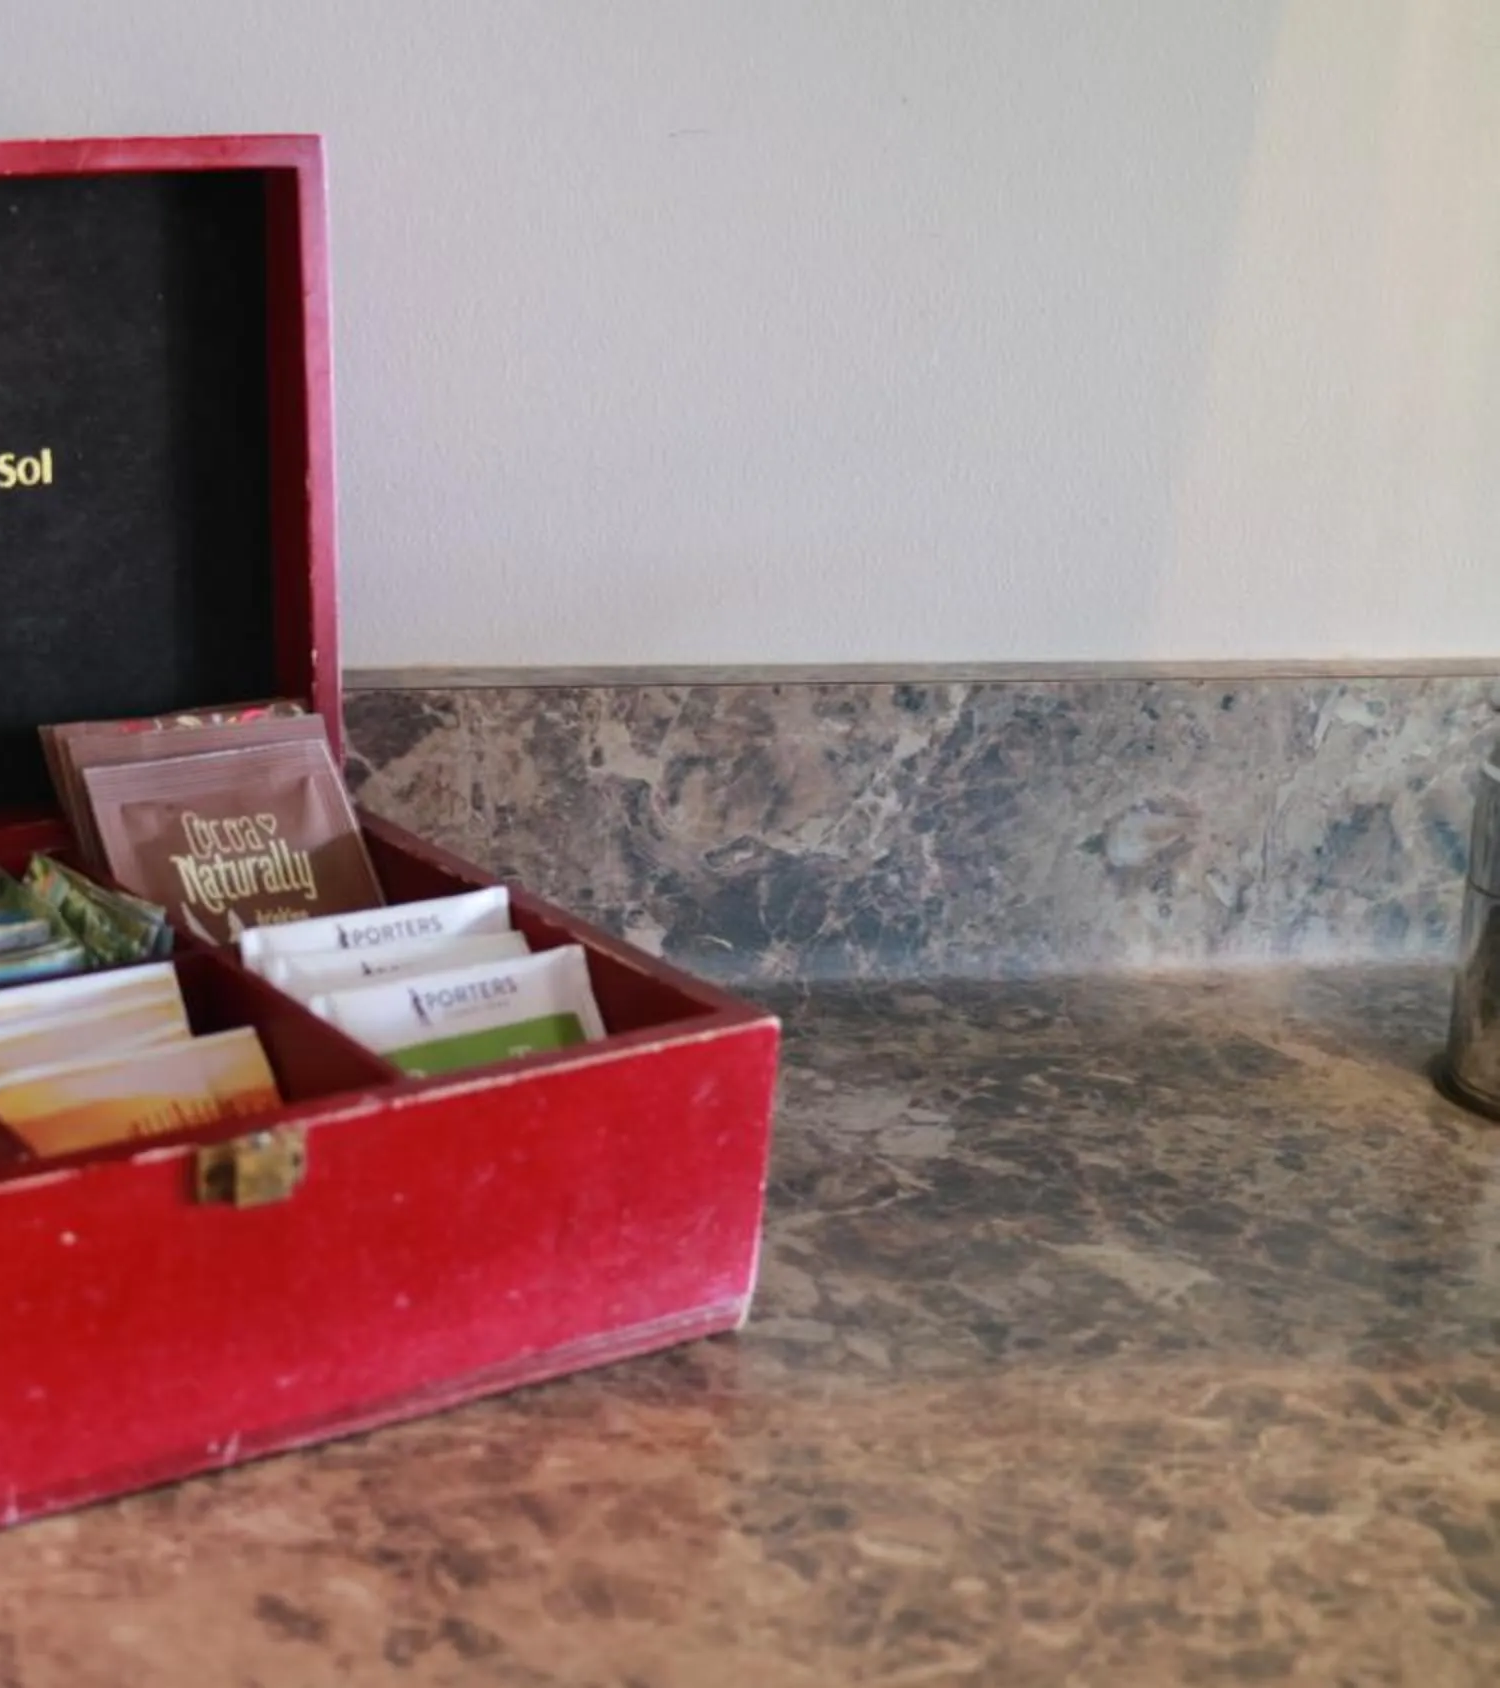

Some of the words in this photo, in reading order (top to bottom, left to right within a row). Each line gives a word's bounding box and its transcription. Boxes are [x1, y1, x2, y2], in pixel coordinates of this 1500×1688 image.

[181, 810, 265, 860] Cocoa
[169, 838, 318, 914] Naturally
[353, 914, 443, 946] PORTERS
[424, 976, 518, 1010] PORTERS
